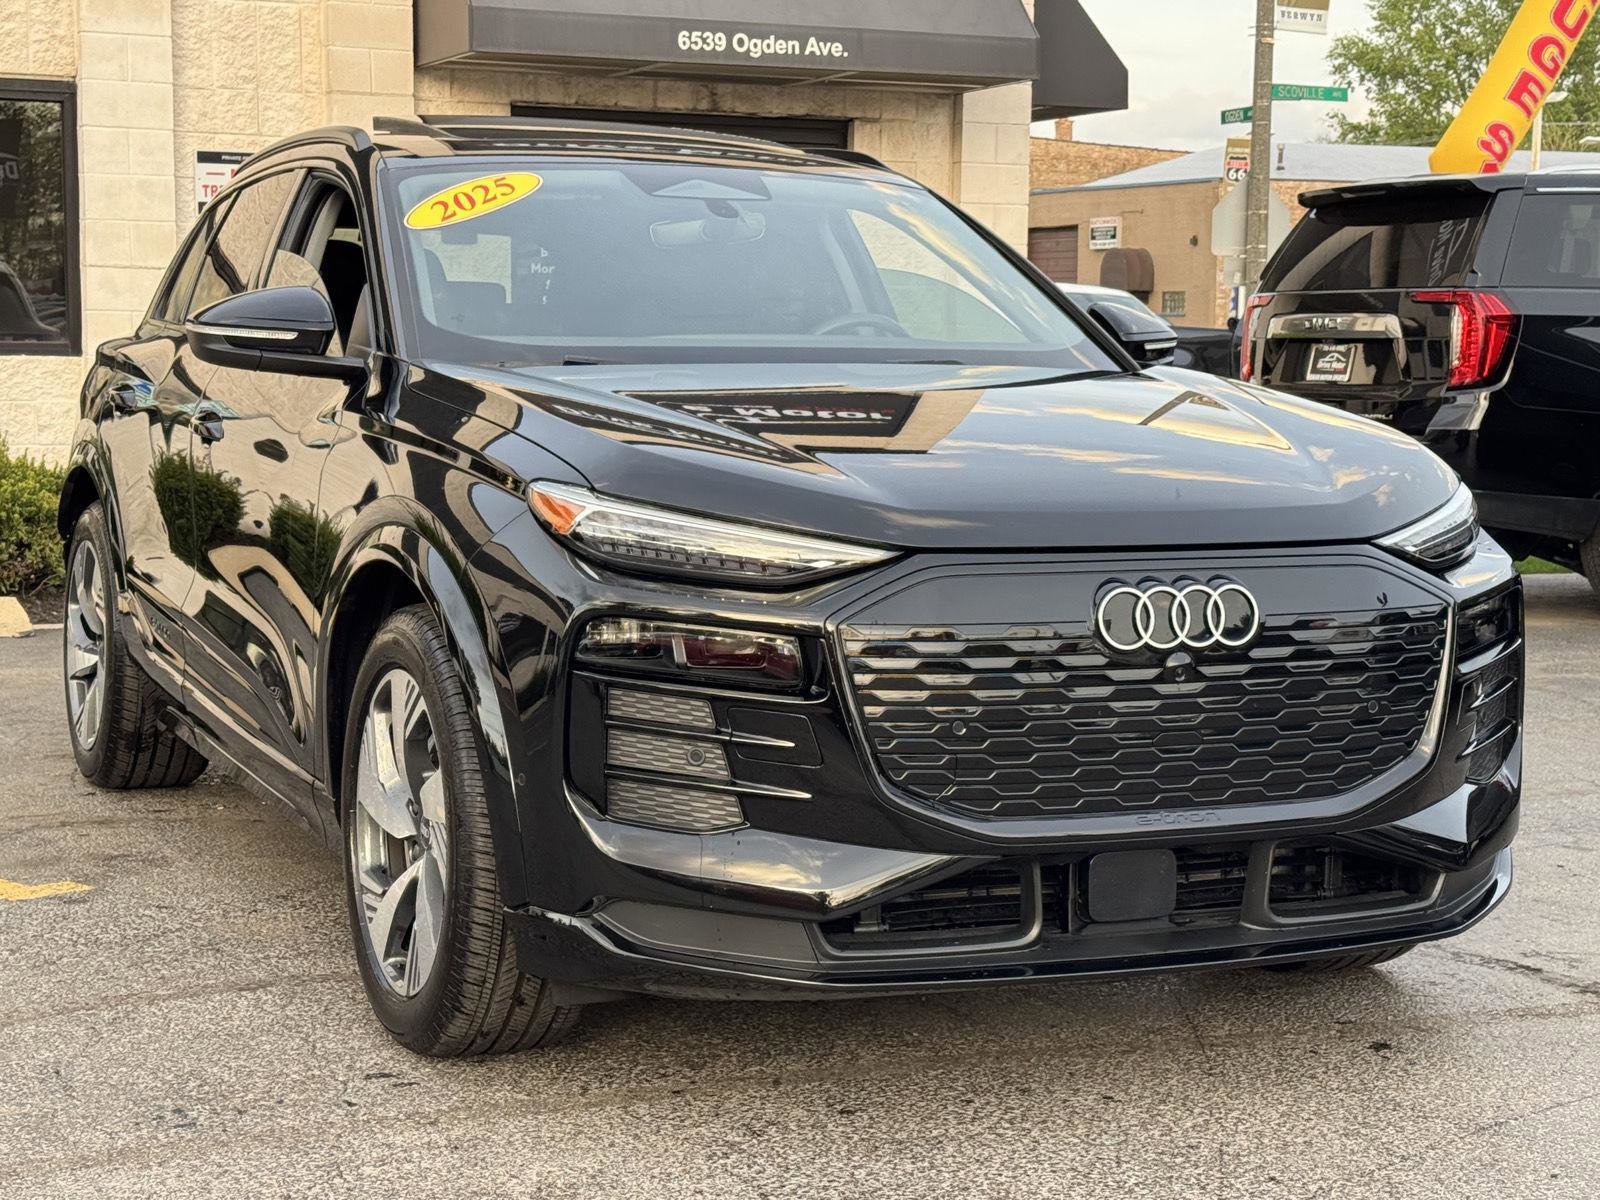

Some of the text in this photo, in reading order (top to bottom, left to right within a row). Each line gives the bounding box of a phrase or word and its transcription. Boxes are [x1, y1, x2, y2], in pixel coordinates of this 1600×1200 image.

[677, 30, 849, 59] 6539 Ogden Ave.
[1278, 86, 1324, 99] SCOVILLE
[1224, 111, 1244, 123] OGDEN
[1228, 168, 1246, 180] 66
[430, 176, 516, 222] 2025
